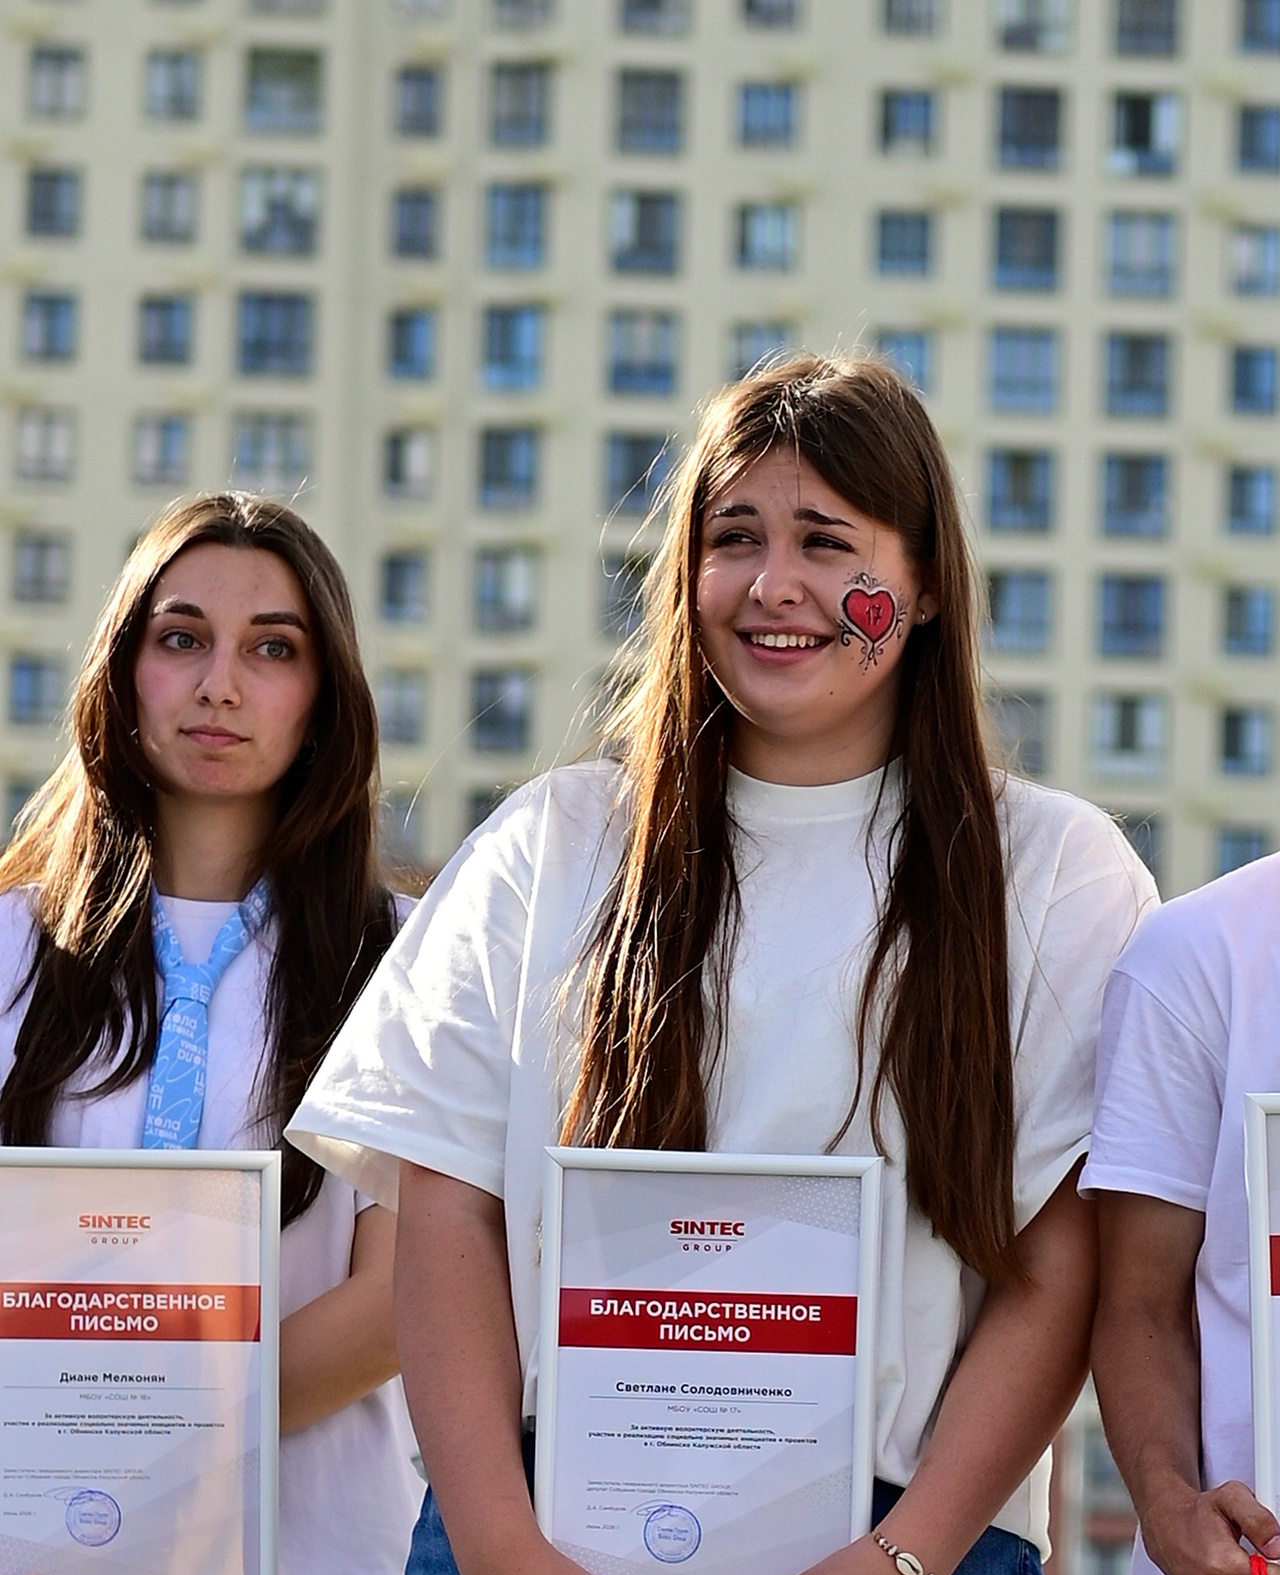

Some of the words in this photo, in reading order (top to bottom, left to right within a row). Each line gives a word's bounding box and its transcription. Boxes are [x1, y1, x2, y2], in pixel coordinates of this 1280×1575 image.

[865, 604, 882, 625] 17
[78, 1214, 151, 1229] SINTEC
[669, 1220, 745, 1236] SINTEC
[90, 1236, 138, 1245] GROUP
[682, 1243, 732, 1252] GROUP
[2, 1291, 226, 1311] БЛАГОДАРСТВЕННОЕ
[590, 1298, 821, 1321] БЛАГОДАРСТВЕННОЕ
[70, 1314, 158, 1331] ПИСЬМО
[659, 1324, 750, 1342] ПИСЬМО
[58, 1371, 99, 1383] Диане
[102, 1372, 165, 1383] Мелконян
[615, 1381, 676, 1394] Светлане
[680, 1383, 792, 1397] Солодовниченко
